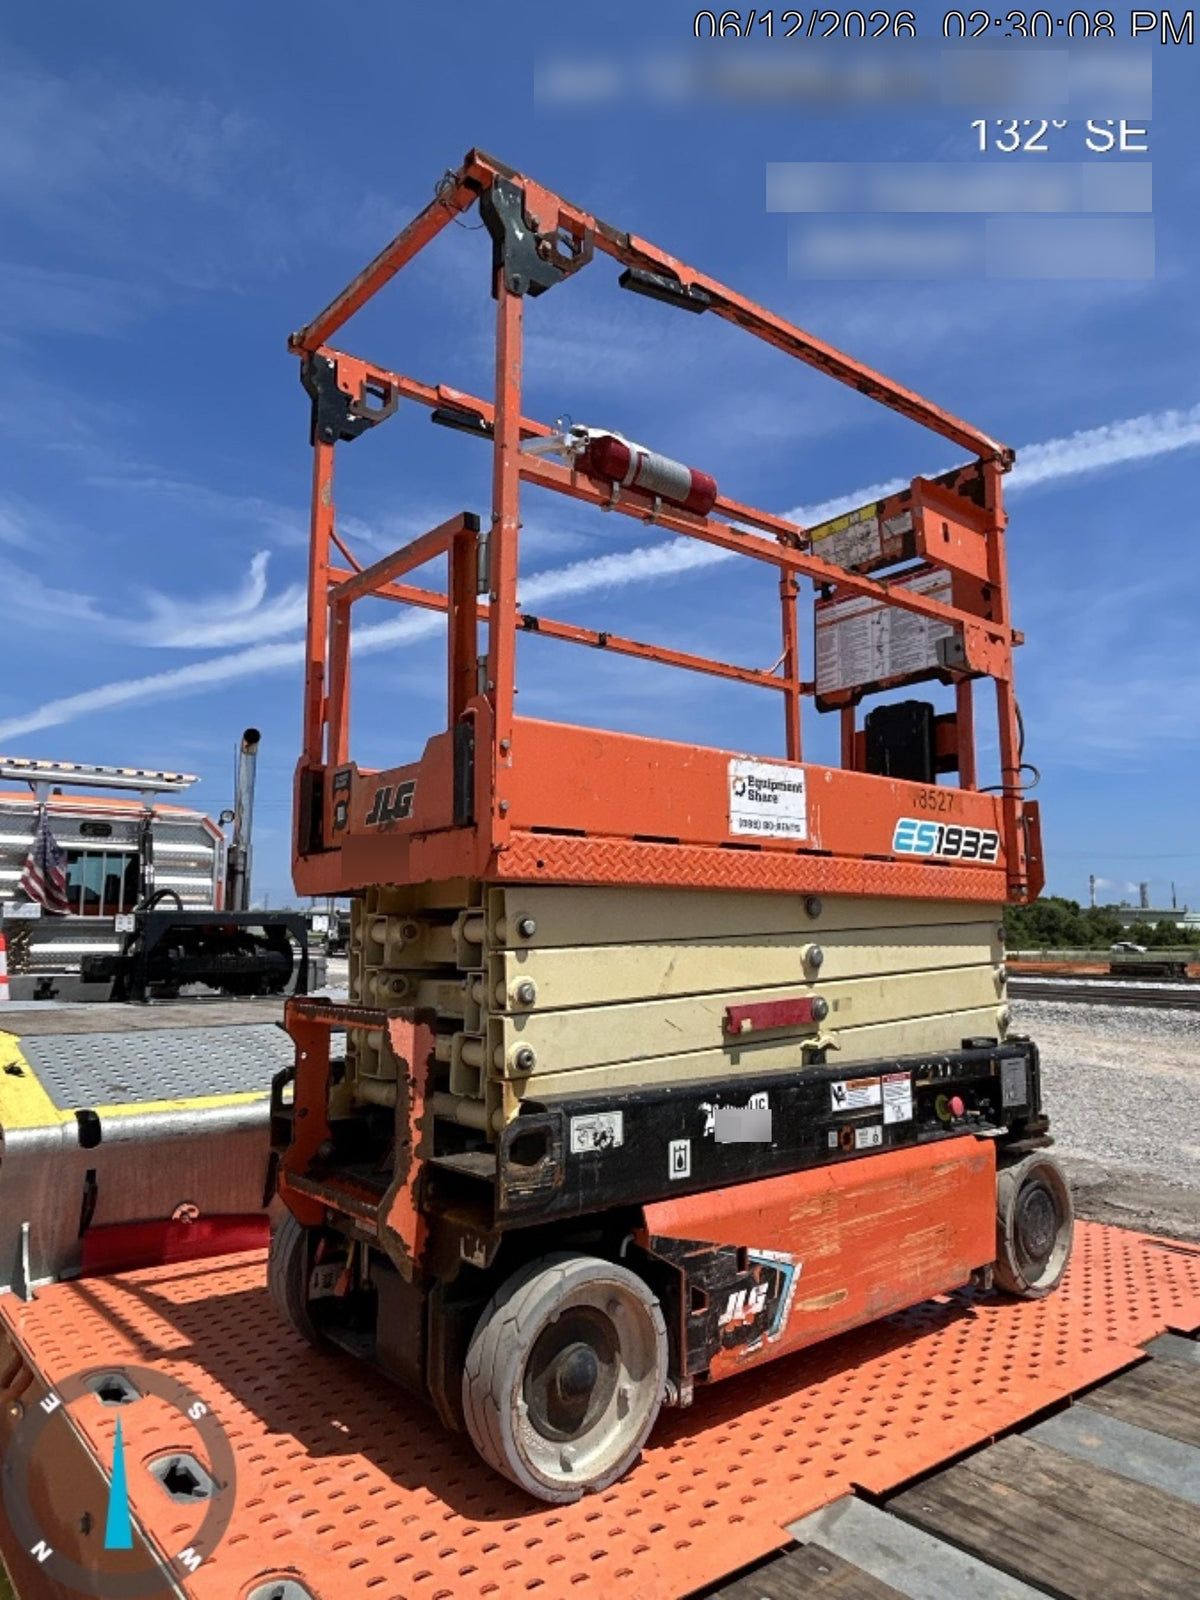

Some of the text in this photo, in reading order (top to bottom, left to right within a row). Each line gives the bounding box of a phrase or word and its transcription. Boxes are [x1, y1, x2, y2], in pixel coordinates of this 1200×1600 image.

[365, 778, 417, 827] JLG
[747, 774, 803, 794] Equipment
[747, 789, 778, 804] Share
[895, 821, 998, 861] ES1932
[718, 1282, 769, 1327] JLG
